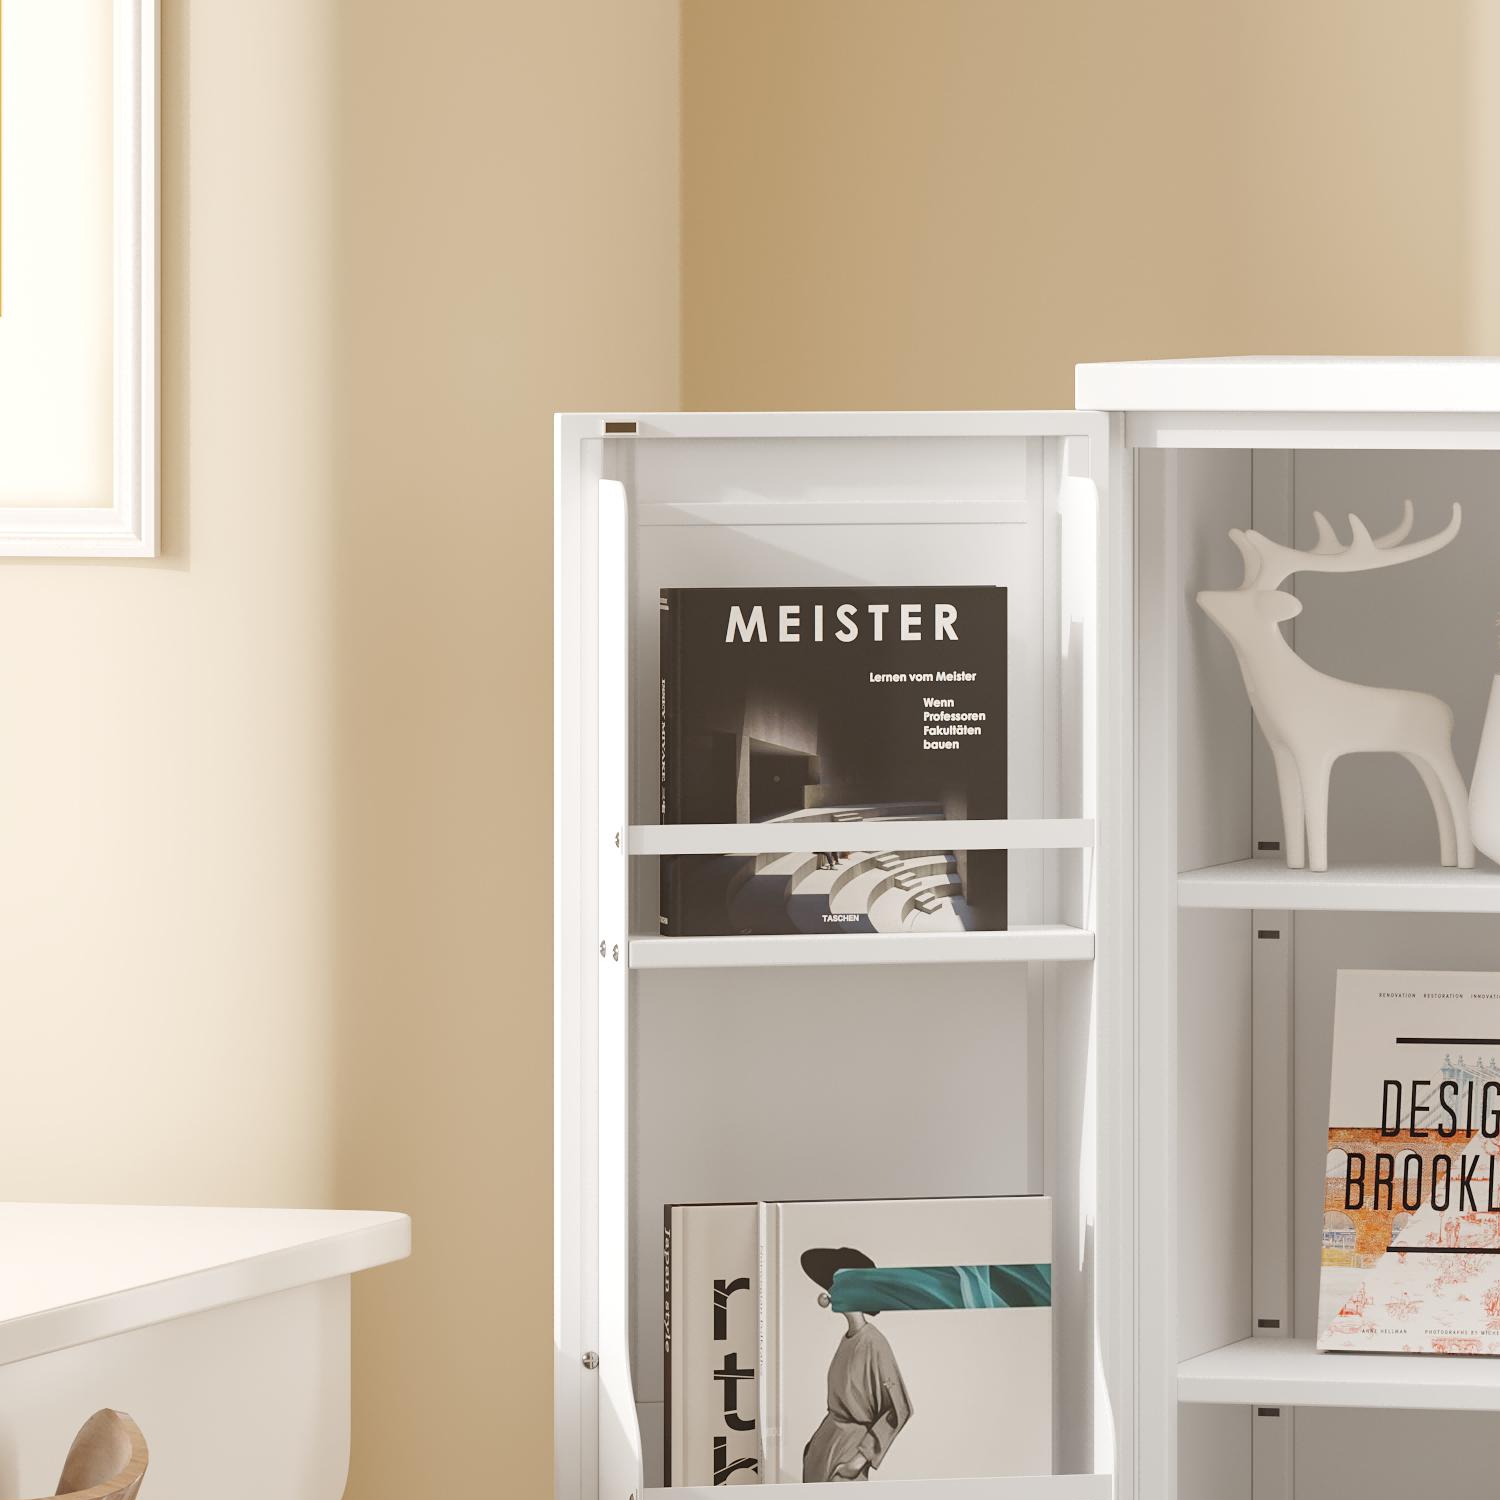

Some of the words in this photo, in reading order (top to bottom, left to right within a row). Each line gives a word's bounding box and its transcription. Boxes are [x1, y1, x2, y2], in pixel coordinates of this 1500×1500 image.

[725, 603, 959, 643] MEISTER
[869, 672, 907, 683] Lernen
[908, 673, 934, 682] vom
[935, 671, 977, 682] Meister
[923, 697, 955, 708] Wenn
[923, 711, 986, 722] Professoren
[923, 724, 982, 736] Fakultäten
[923, 739, 960, 750] bauen
[822, 913, 860, 924] TASCHEN
